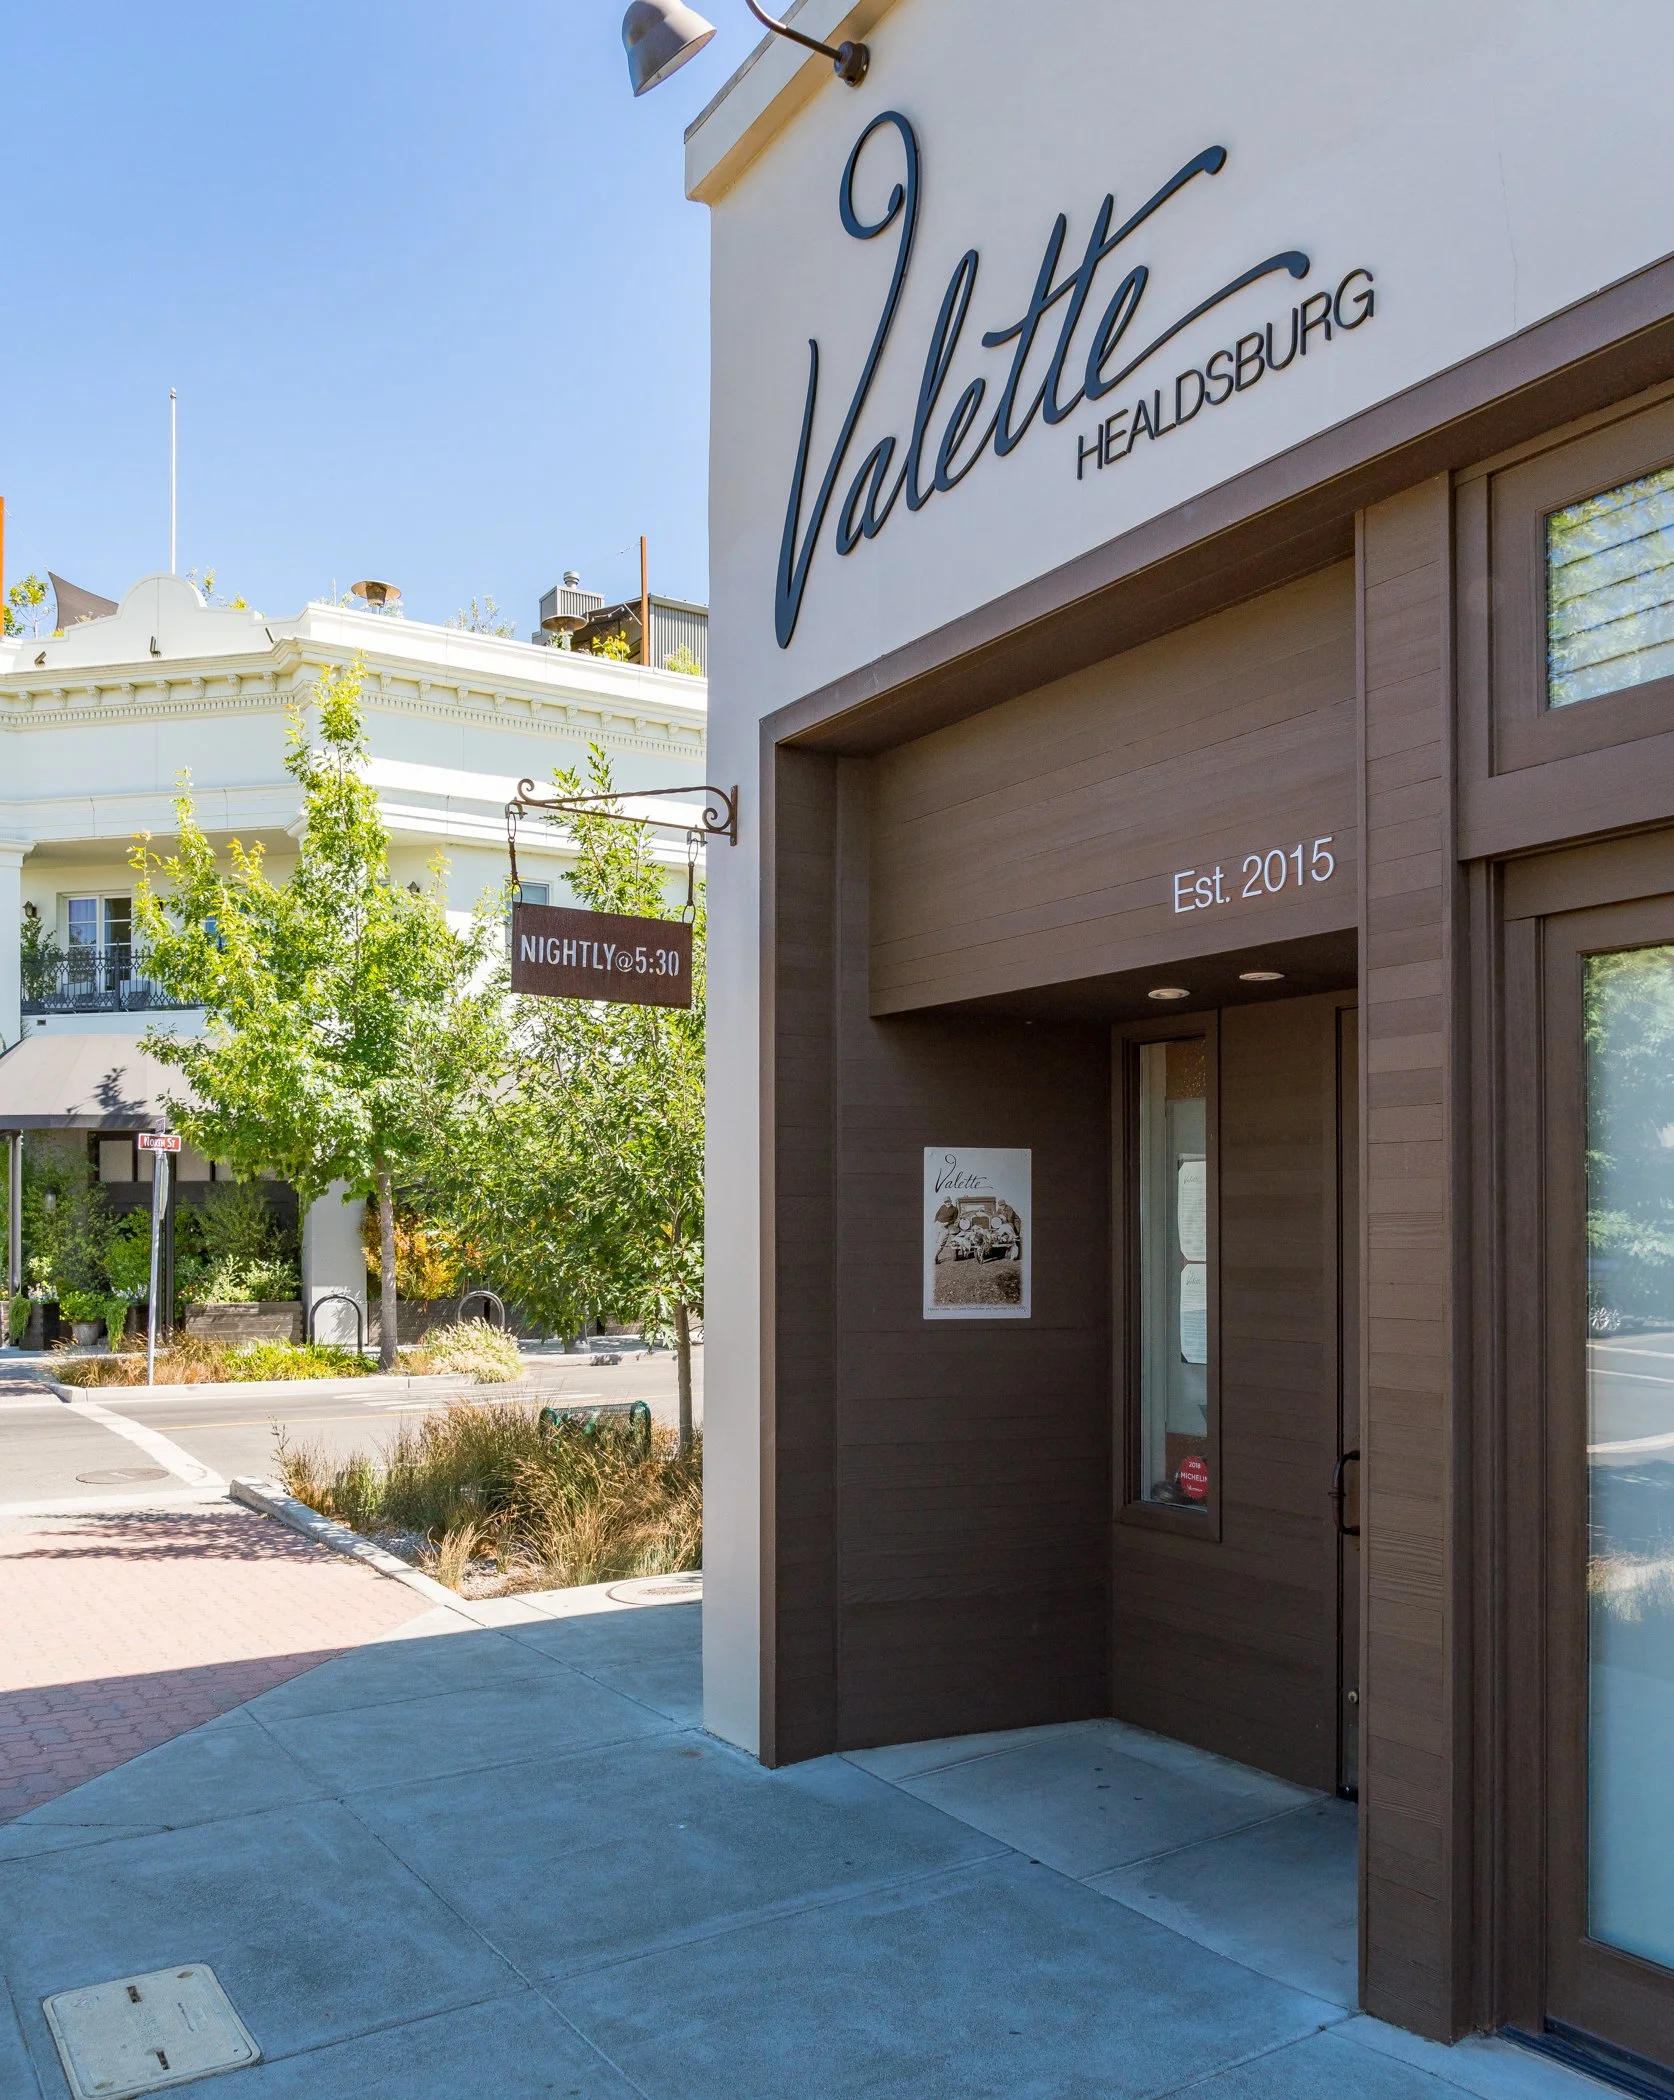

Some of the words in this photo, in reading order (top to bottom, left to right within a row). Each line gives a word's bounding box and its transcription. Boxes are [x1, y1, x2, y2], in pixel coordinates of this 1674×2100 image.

[775, 110, 1310, 649] Valette
[1076, 268, 1375, 480] HEALDSBURG
[1173, 866, 1232, 914] Est.
[1242, 836, 1335, 898] 2015
[934, 1153, 994, 1194] Valette
[1180, 1471, 1208, 1482] MICHELIN
